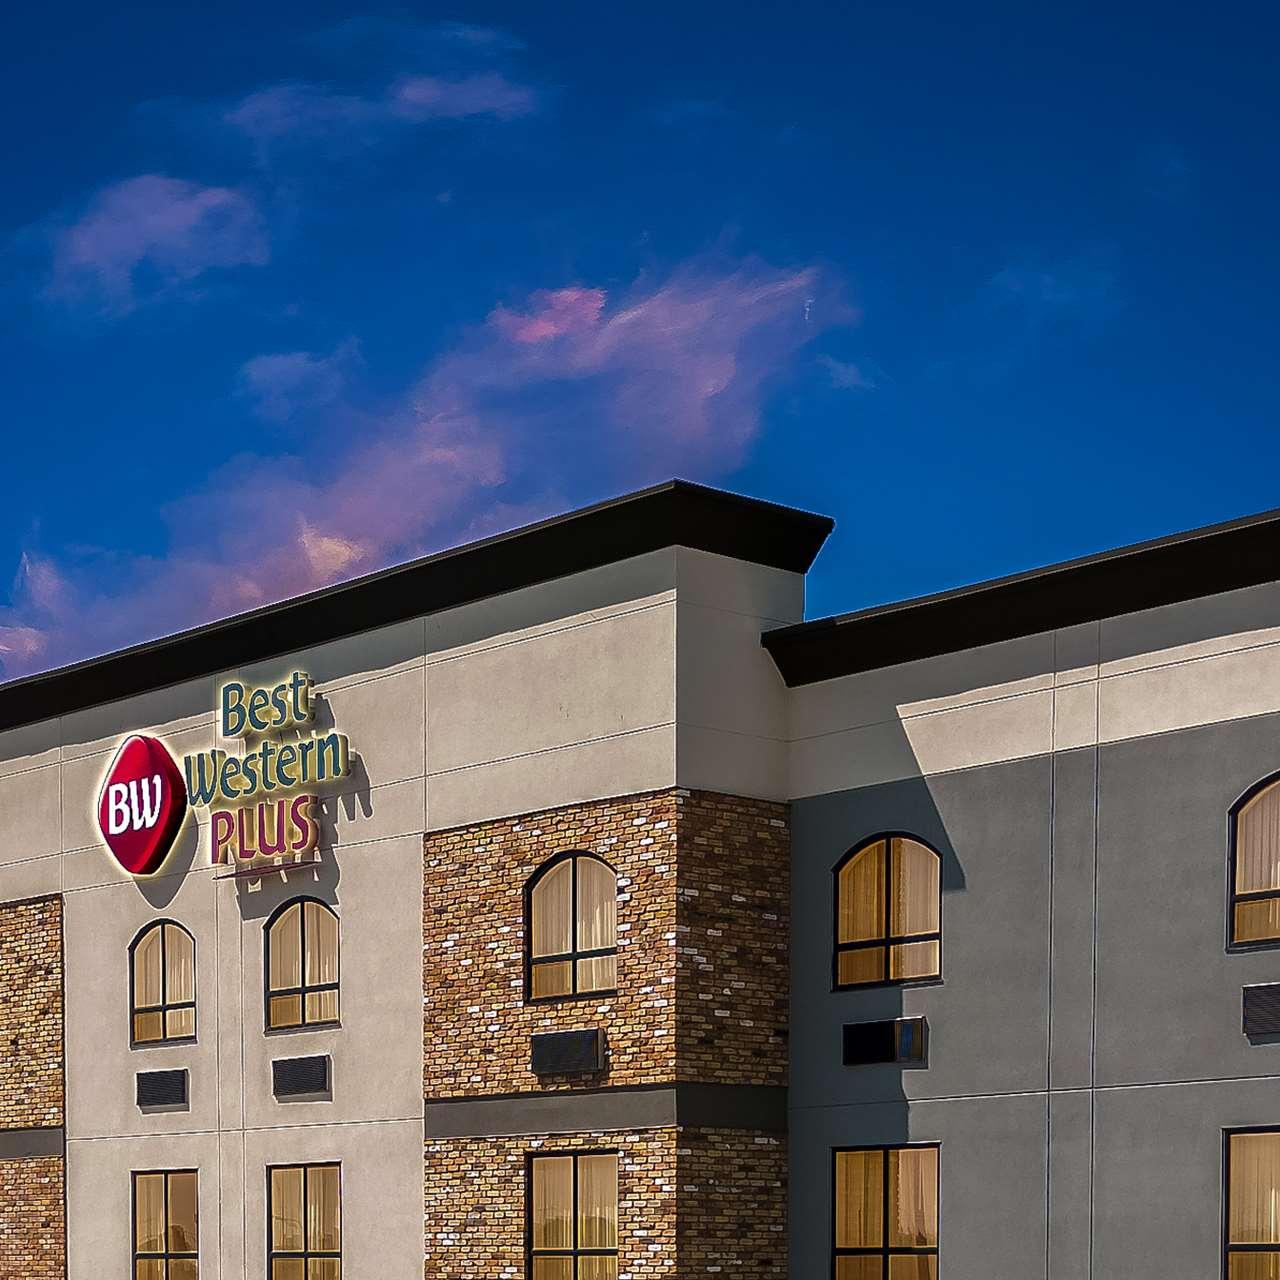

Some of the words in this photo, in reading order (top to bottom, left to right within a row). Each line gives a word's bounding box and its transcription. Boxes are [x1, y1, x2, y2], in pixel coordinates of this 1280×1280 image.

[222, 671, 307, 737] Best
[184, 733, 342, 806] Western
[108, 774, 162, 835] BW
[211, 795, 310, 864] PLUS
